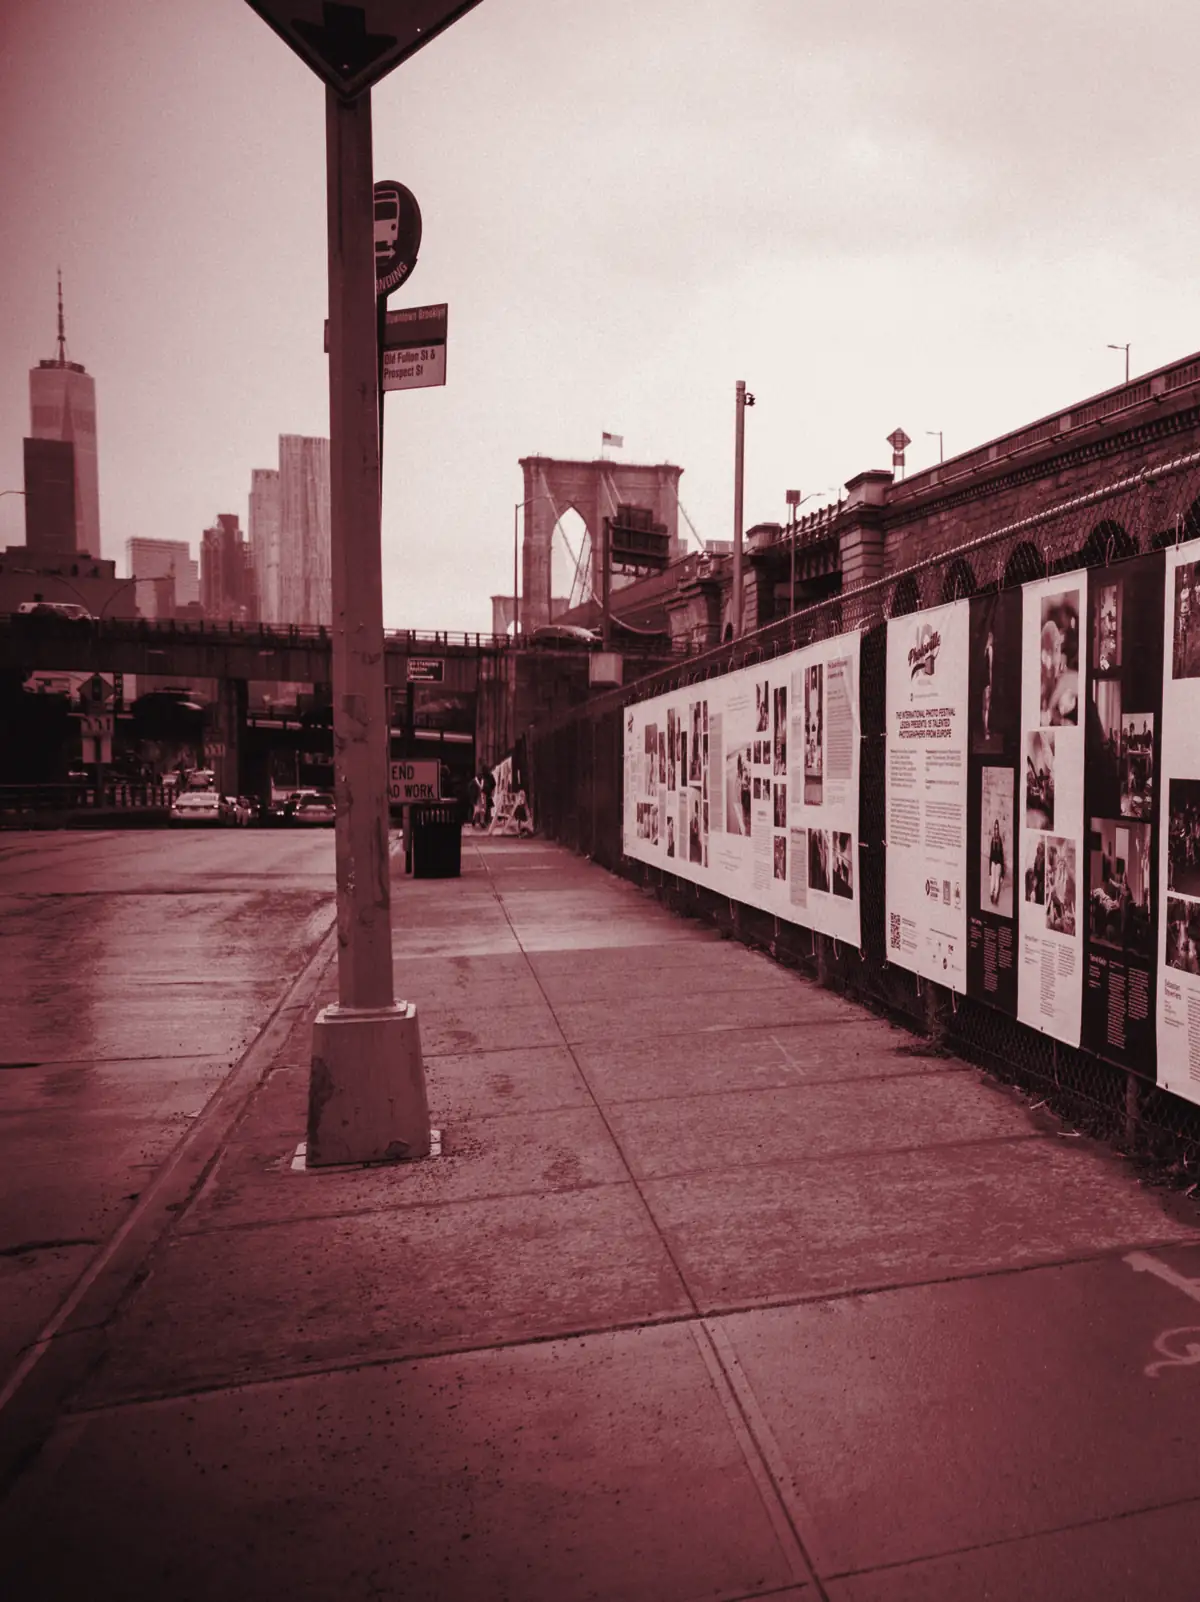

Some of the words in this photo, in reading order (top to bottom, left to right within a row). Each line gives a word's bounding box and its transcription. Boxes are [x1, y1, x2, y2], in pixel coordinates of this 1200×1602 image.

[397, 352, 419, 363] Fulton
[384, 367, 414, 381] Prospect
[392, 765, 415, 781] END
[404, 783, 434, 799] WORK
